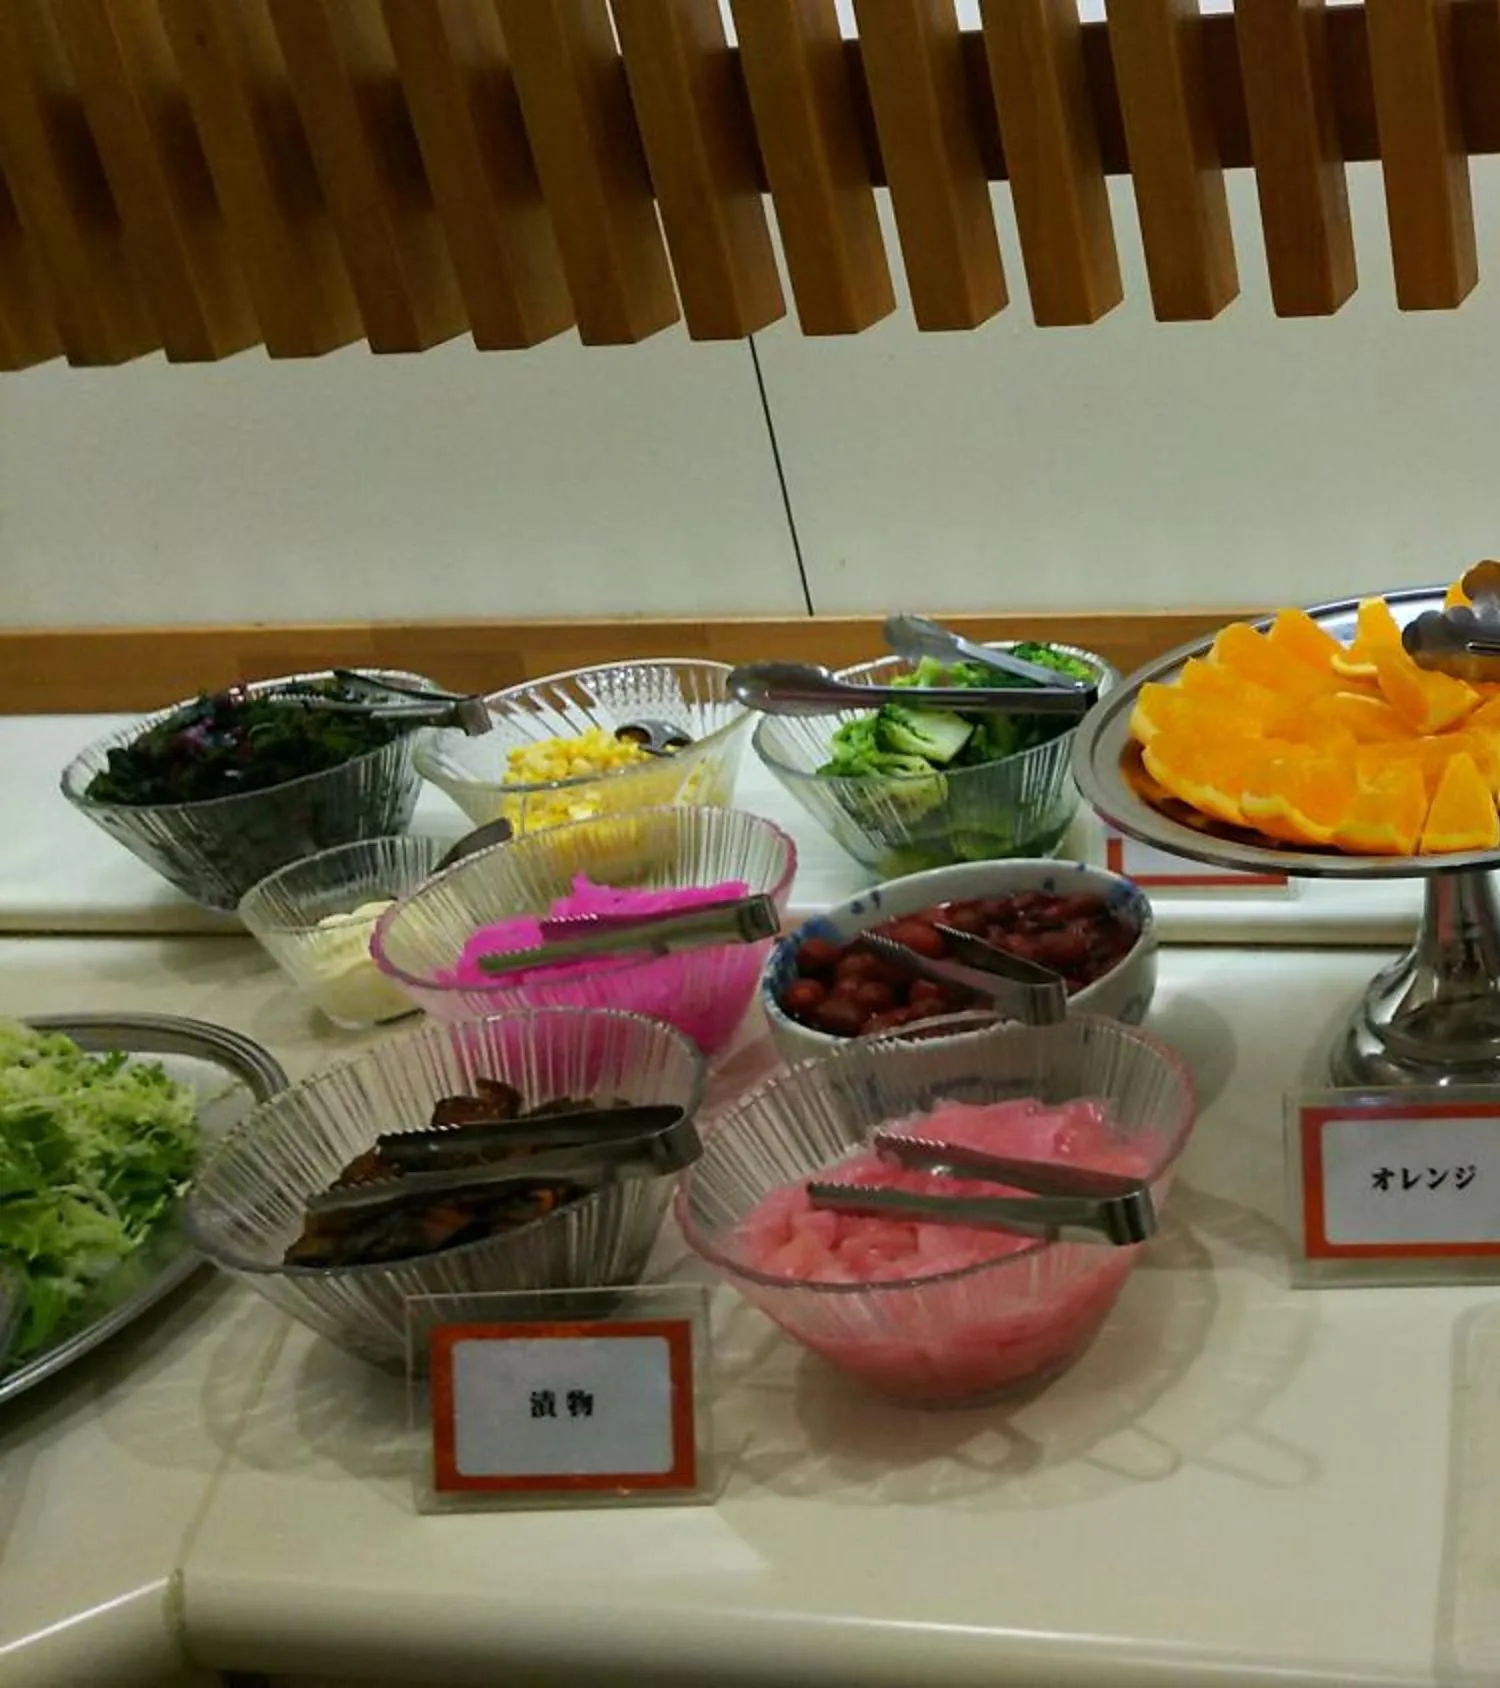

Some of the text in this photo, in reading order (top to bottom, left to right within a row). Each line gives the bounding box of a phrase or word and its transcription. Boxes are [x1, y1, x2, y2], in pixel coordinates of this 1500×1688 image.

[1371, 1164, 1477, 1191] オレンジ
[529, 1389, 594, 1418] 漬物
